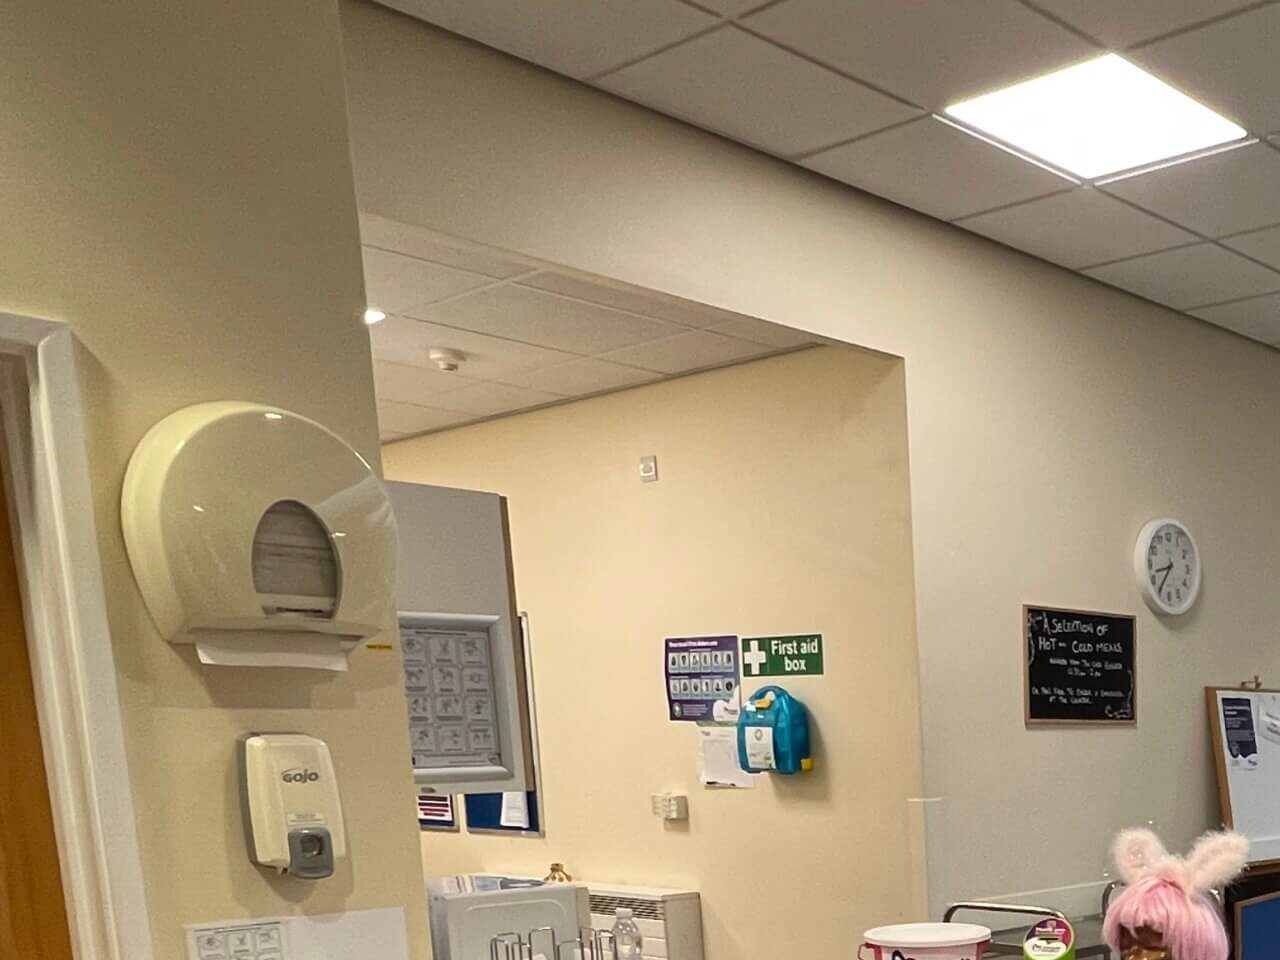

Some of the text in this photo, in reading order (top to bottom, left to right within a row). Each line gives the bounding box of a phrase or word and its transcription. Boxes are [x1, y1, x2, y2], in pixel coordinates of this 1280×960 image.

[1096, 624, 1109, 636] OF
[770, 637, 818, 655] First aid
[1071, 641, 1093, 653] COLD
[1096, 642, 1122, 653] MEALS
[784, 655, 806, 672] box
